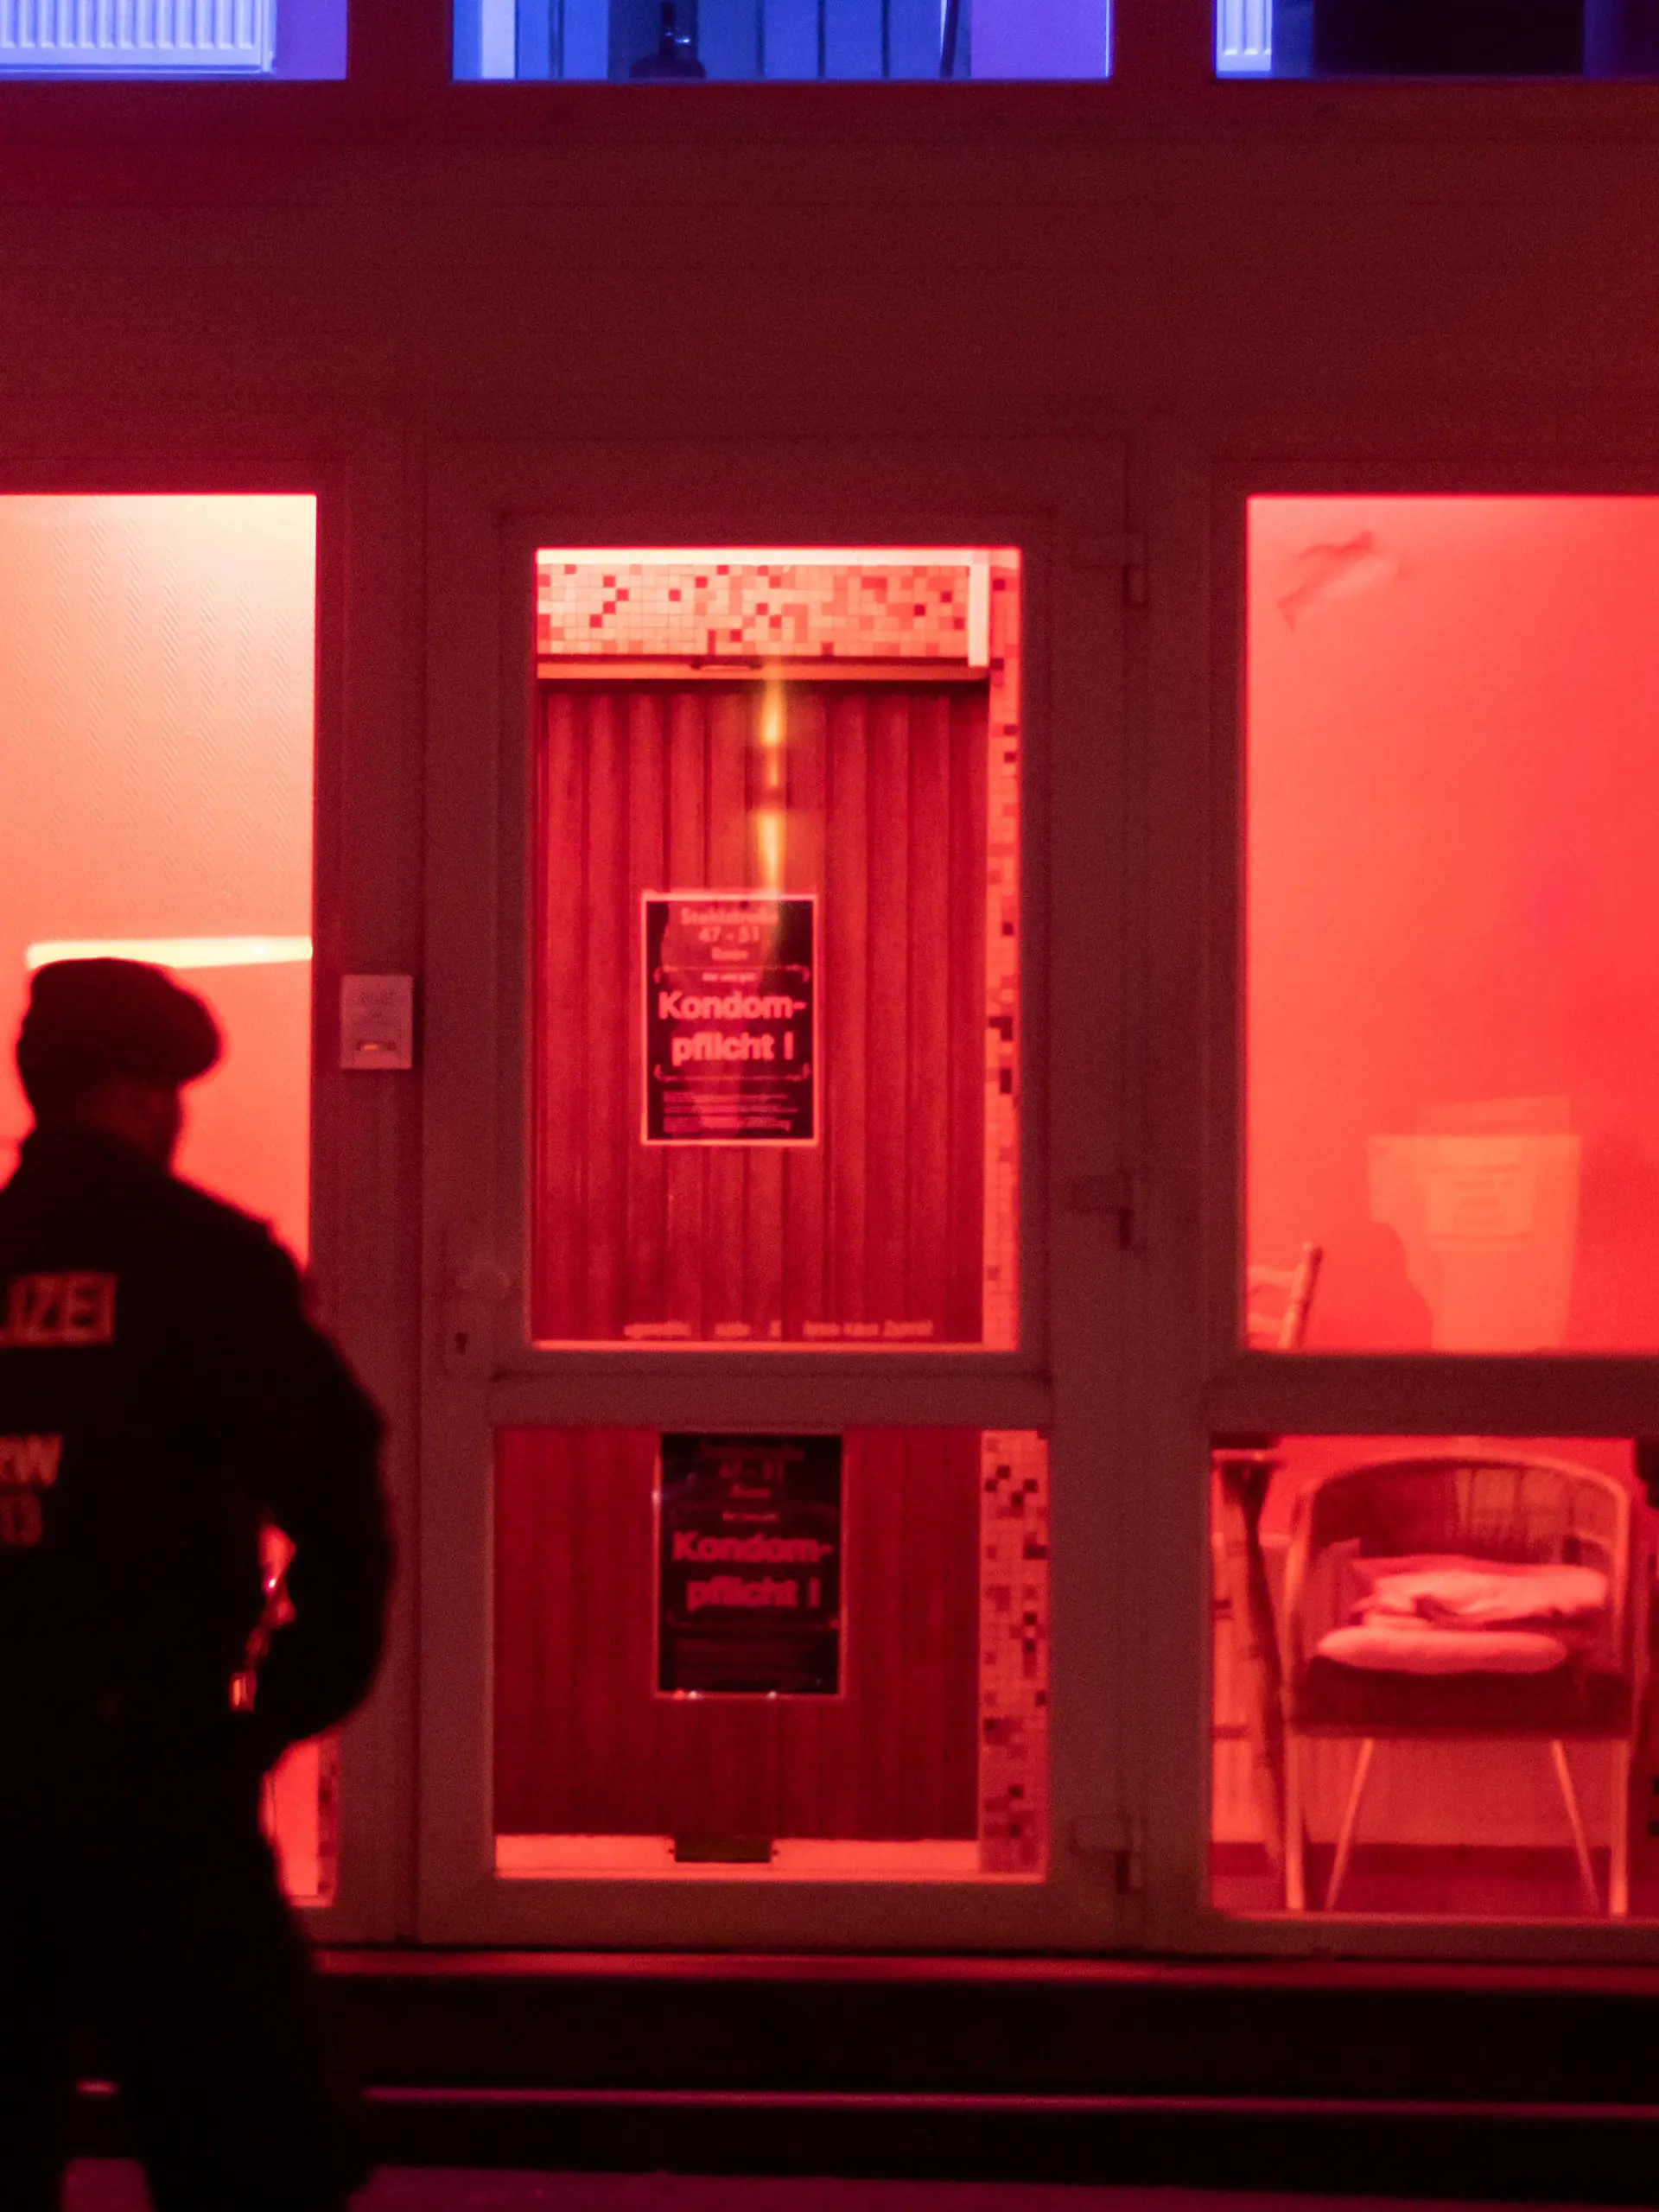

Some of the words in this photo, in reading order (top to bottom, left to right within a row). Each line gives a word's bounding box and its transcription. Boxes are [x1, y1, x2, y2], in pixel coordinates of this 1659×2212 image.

[658, 991, 807, 1020] Kondom-
[672, 1031, 775, 1066] pflicht
[673, 1530, 833, 1563] Kondom-
[686, 1575, 799, 1612] pflicht
